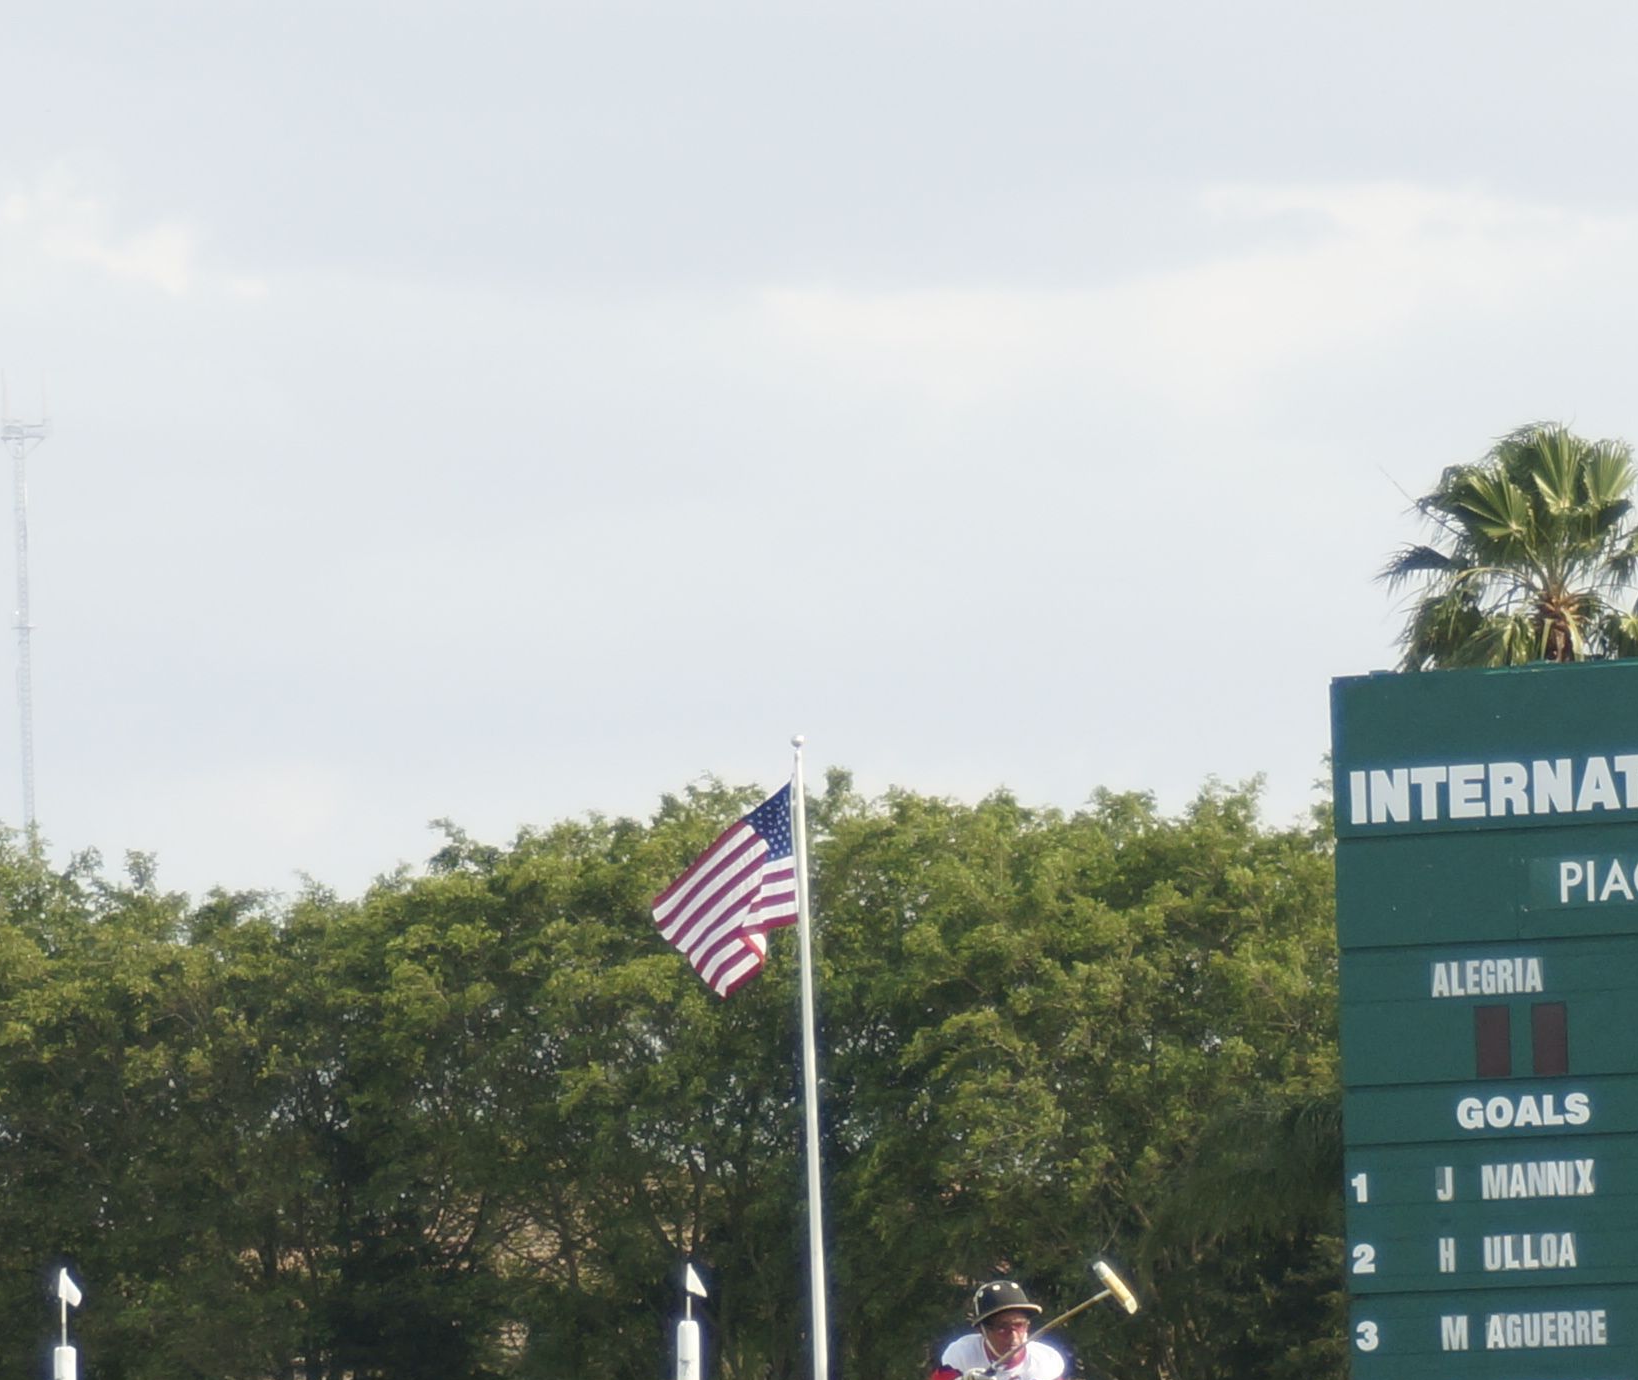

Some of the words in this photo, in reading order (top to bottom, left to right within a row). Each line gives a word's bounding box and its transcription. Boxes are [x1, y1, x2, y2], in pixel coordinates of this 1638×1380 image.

[1431, 958, 1543, 997] ALEGRIA
[1457, 1093, 1590, 1129] GOALS
[1351, 1173, 1367, 1202] 1
[1437, 1167, 1453, 1200] J
[1481, 1160, 1594, 1199] MANNIX
[1352, 1244, 1375, 1273] 2
[1439, 1238, 1455, 1272] H
[1484, 1233, 1576, 1270] ULLOA
[1356, 1321, 1378, 1351] 3
[1441, 1316, 1468, 1350] M
[1486, 1310, 1606, 1349] AGUERRE
